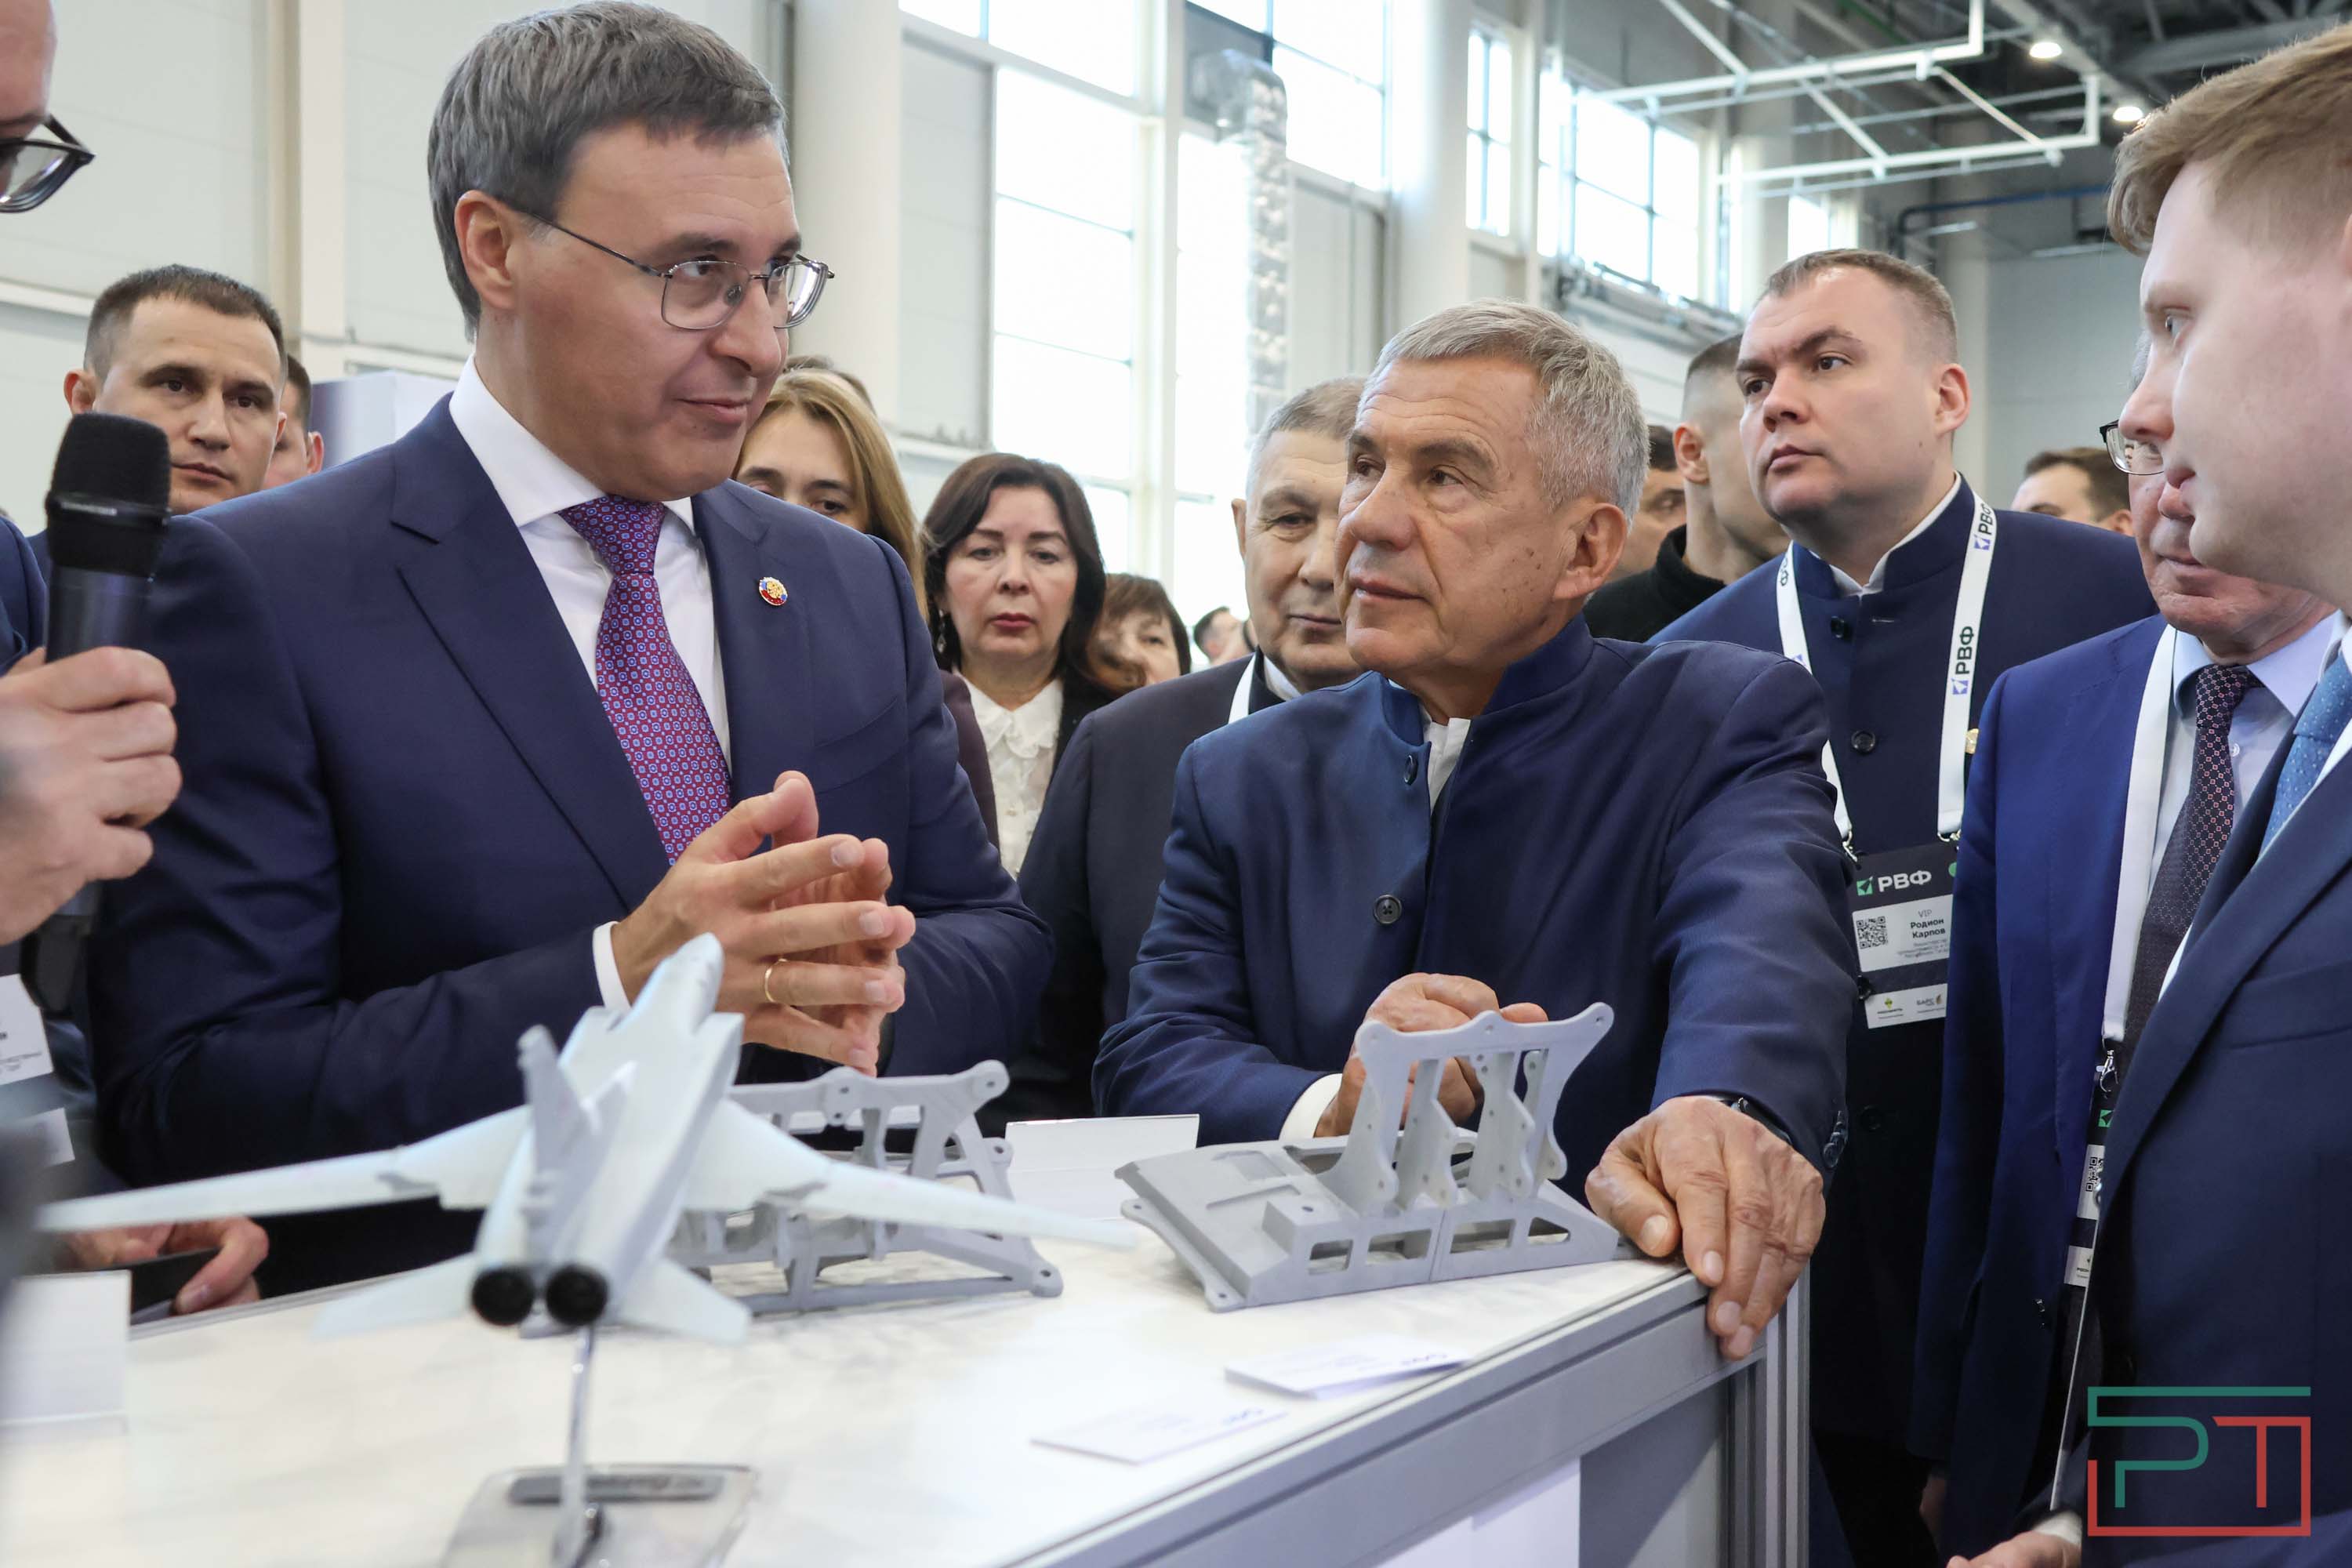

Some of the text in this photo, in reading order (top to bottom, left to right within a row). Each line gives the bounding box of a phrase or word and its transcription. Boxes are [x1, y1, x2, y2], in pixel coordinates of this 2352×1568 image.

[1955, 626, 1974, 674] РВФ
[1878, 870, 1932, 892] РВФ
[1910, 918, 1944, 929] Родион
[1911, 927, 1946, 939] Карпов
